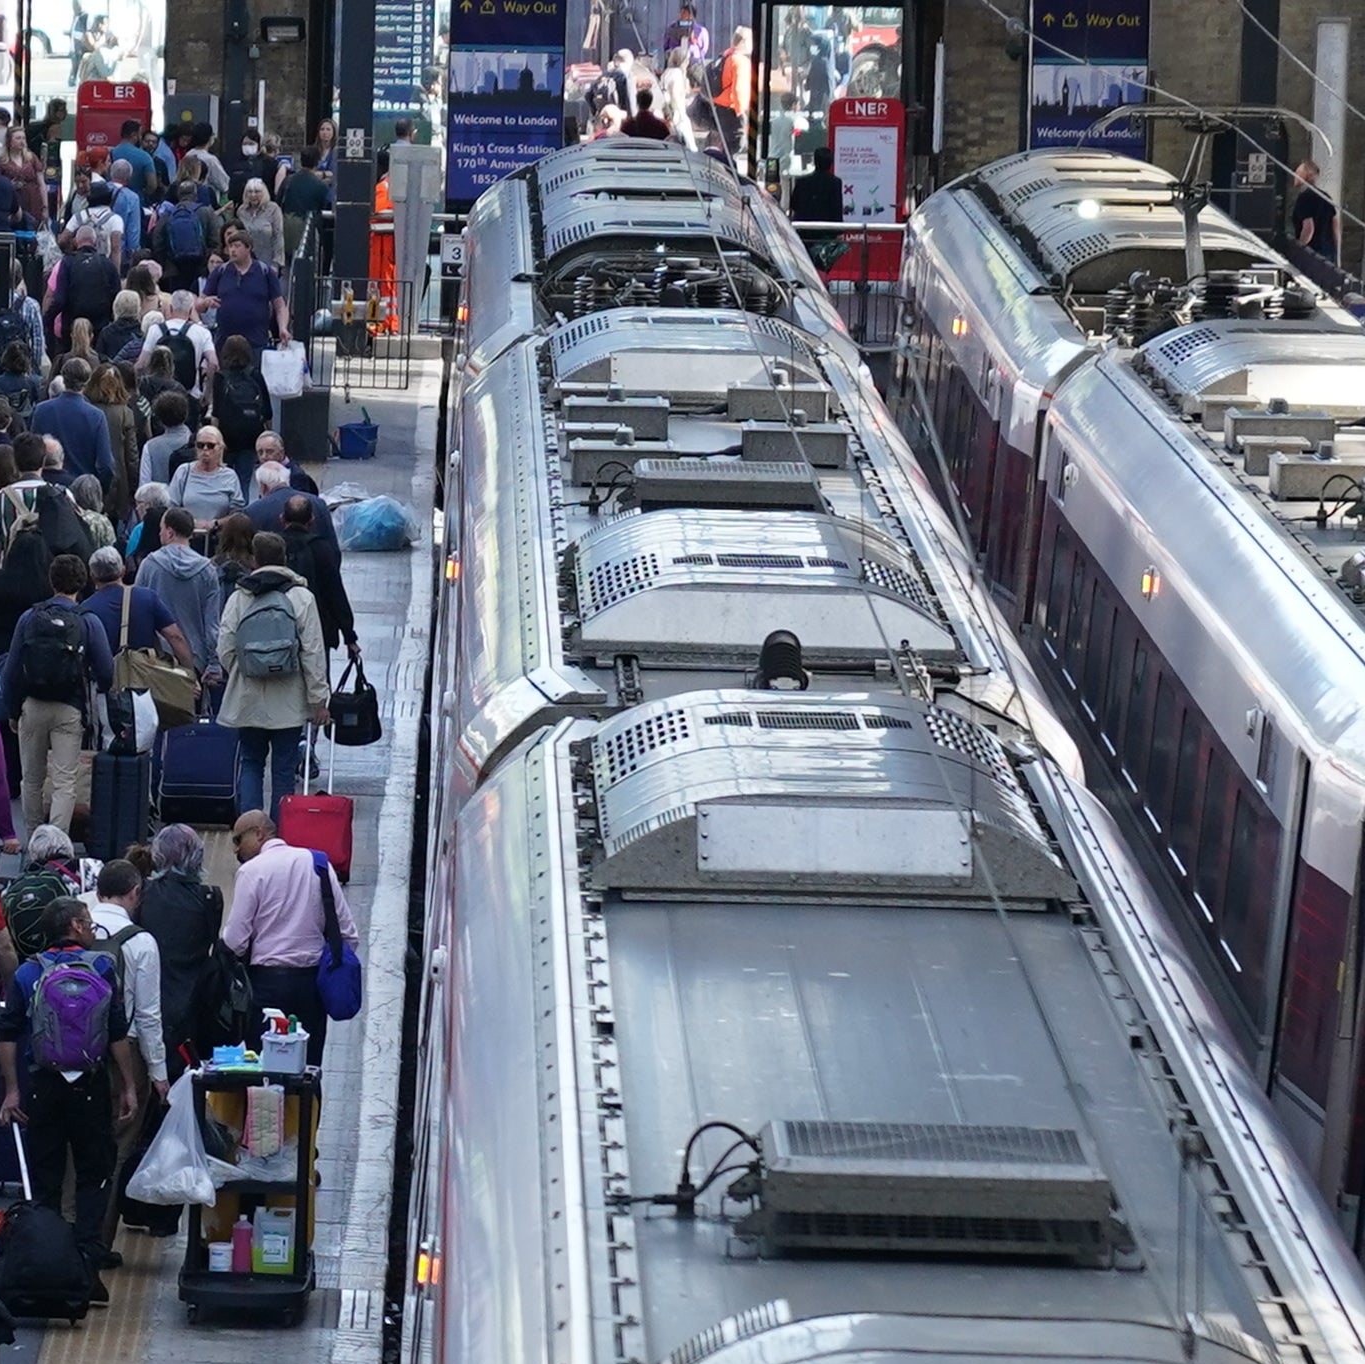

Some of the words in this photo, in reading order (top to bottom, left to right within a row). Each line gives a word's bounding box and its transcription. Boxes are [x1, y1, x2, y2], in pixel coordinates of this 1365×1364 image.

[504, 2, 533, 15] Way
[534, 2, 557, 14] Out
[1086, 13, 1114, 28] Way
[1117, 14, 1141, 26] Out
[845, 101, 888, 115] LNER
[454, 114, 502, 125] Welcome
[504, 115, 516, 125] to
[518, 115, 557, 126] London
[1037, 127, 1085, 138] Welcome
[1089, 128, 1099, 138] to
[453, 143, 485, 155] King's
[487, 144, 515, 154] Cross
[517, 144, 556, 155] Station
[457, 157, 487, 169] 170th
[471, 174, 498, 184] 1852
[452, 247, 462, 260] 3
